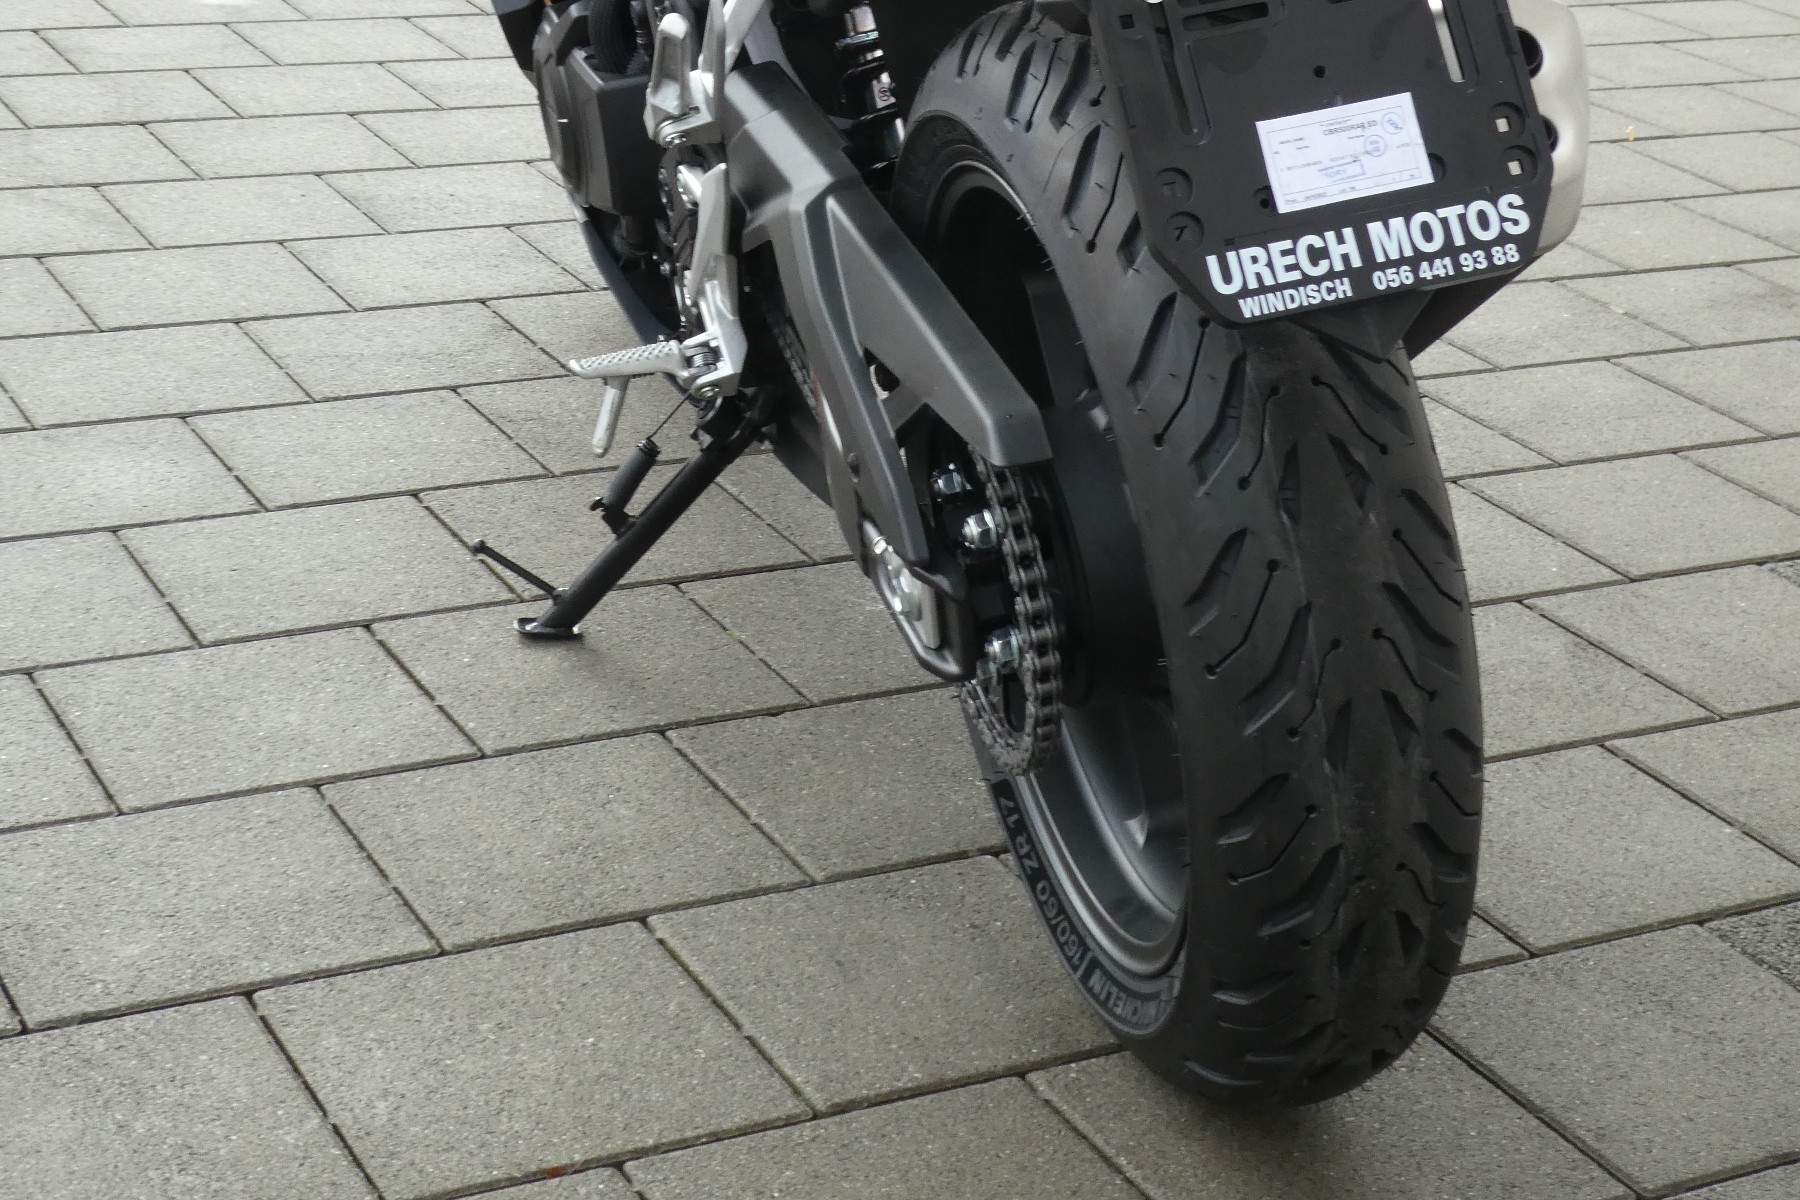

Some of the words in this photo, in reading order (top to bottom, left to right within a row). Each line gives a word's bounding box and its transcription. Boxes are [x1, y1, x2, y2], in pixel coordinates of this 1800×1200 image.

[1205, 227, 1363, 295] URECH
[1366, 193, 1531, 263] MOTOS
[1237, 277, 1353, 318] WINDISCH
[1372, 265, 1415, 291] 056
[1418, 256, 1456, 280] 441
[1458, 249, 1489, 273] 93
[1490, 243, 1521, 266] 88
[1000, 797, 1021, 828] 17
[1014, 832, 1041, 875] ZR
[1036, 879, 1083, 966] 160/60
